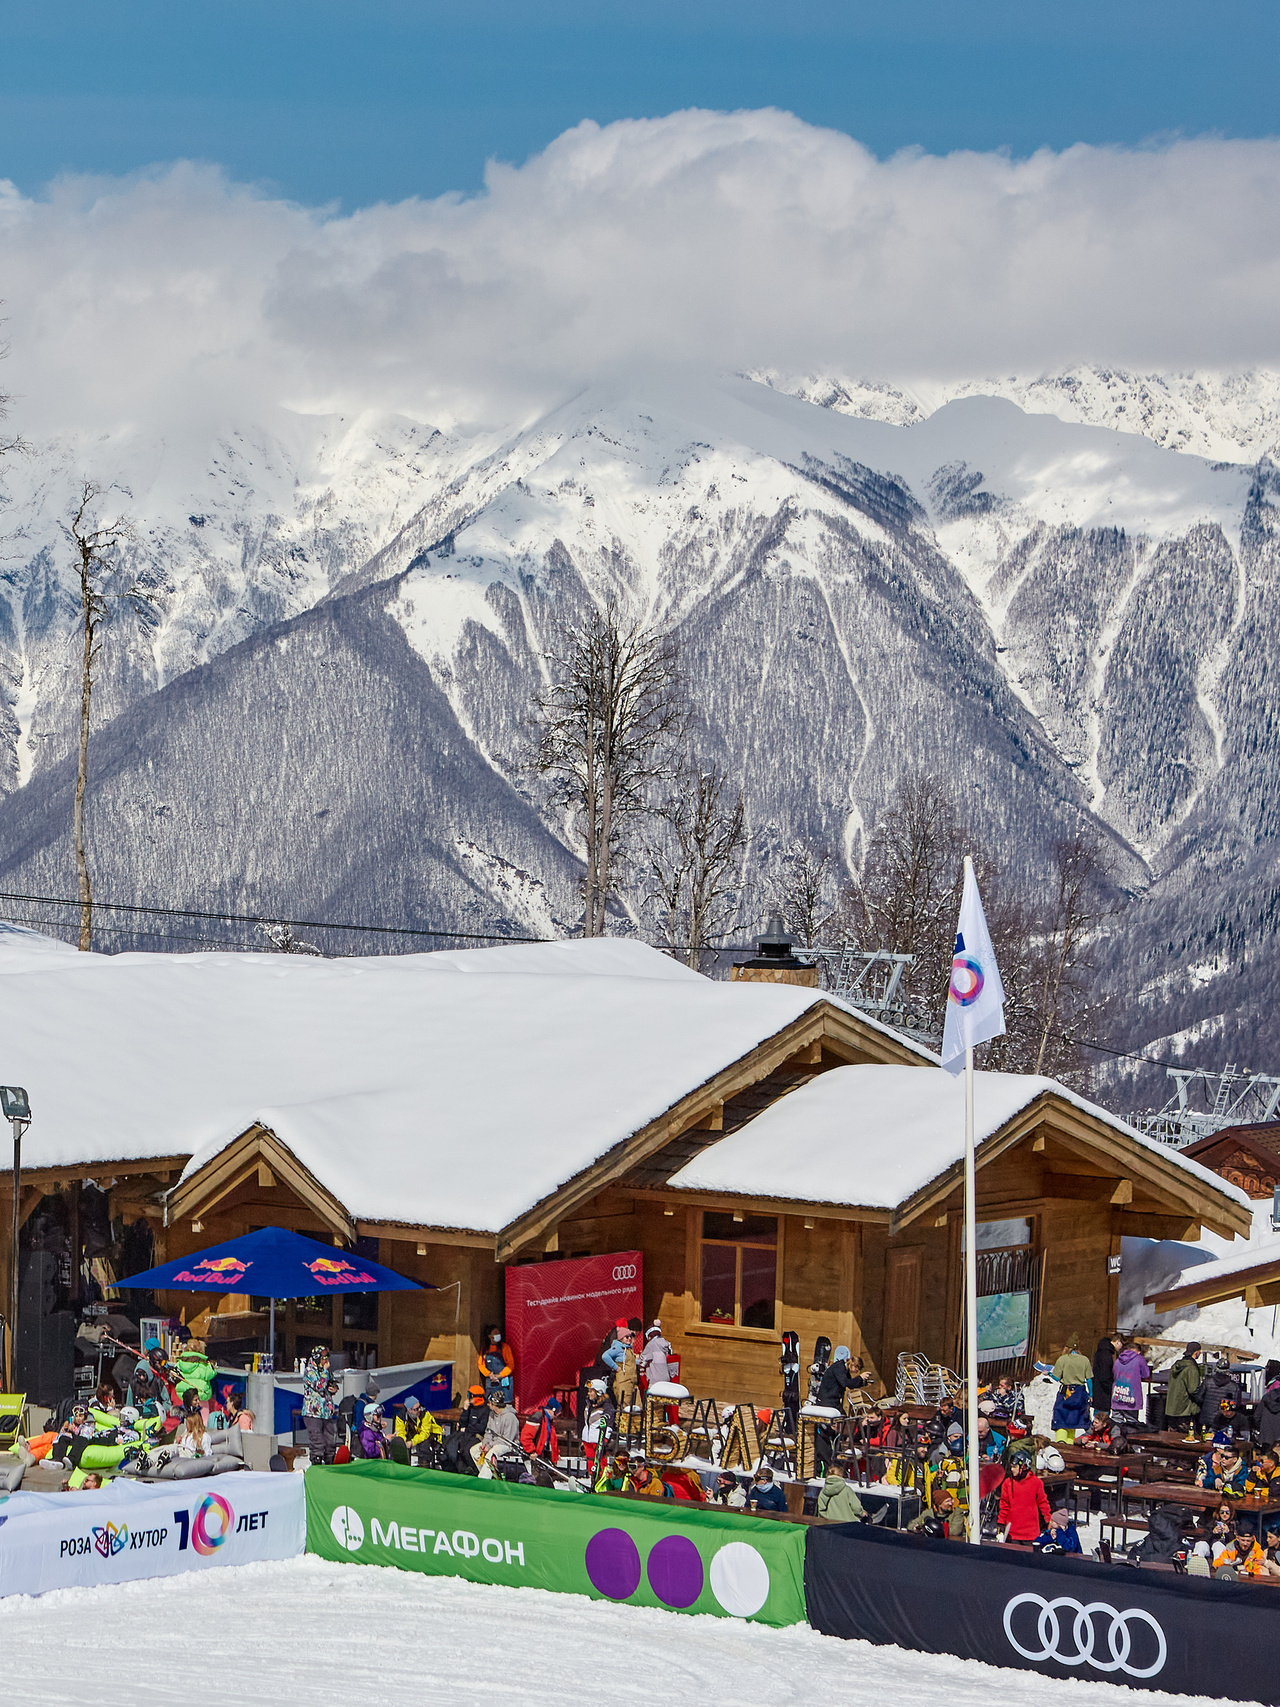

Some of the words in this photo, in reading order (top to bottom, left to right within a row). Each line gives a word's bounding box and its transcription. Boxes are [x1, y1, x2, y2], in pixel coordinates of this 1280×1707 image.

[1110, 1256, 1121, 1268] WC
[172, 1271, 211, 1282] Red
[204, 1272, 244, 1285] Bull
[313, 1273, 351, 1286] Red
[342, 1272, 377, 1284] Bull
[622, 1286, 637, 1294] ряда
[174, 1492, 235, 1557] 10
[235, 1511, 269, 1532] ЛЕТ
[60, 1540, 92, 1558] РОЗА
[130, 1528, 168, 1550] ХУТОР
[371, 1517, 526, 1567] МЕГАФОН
